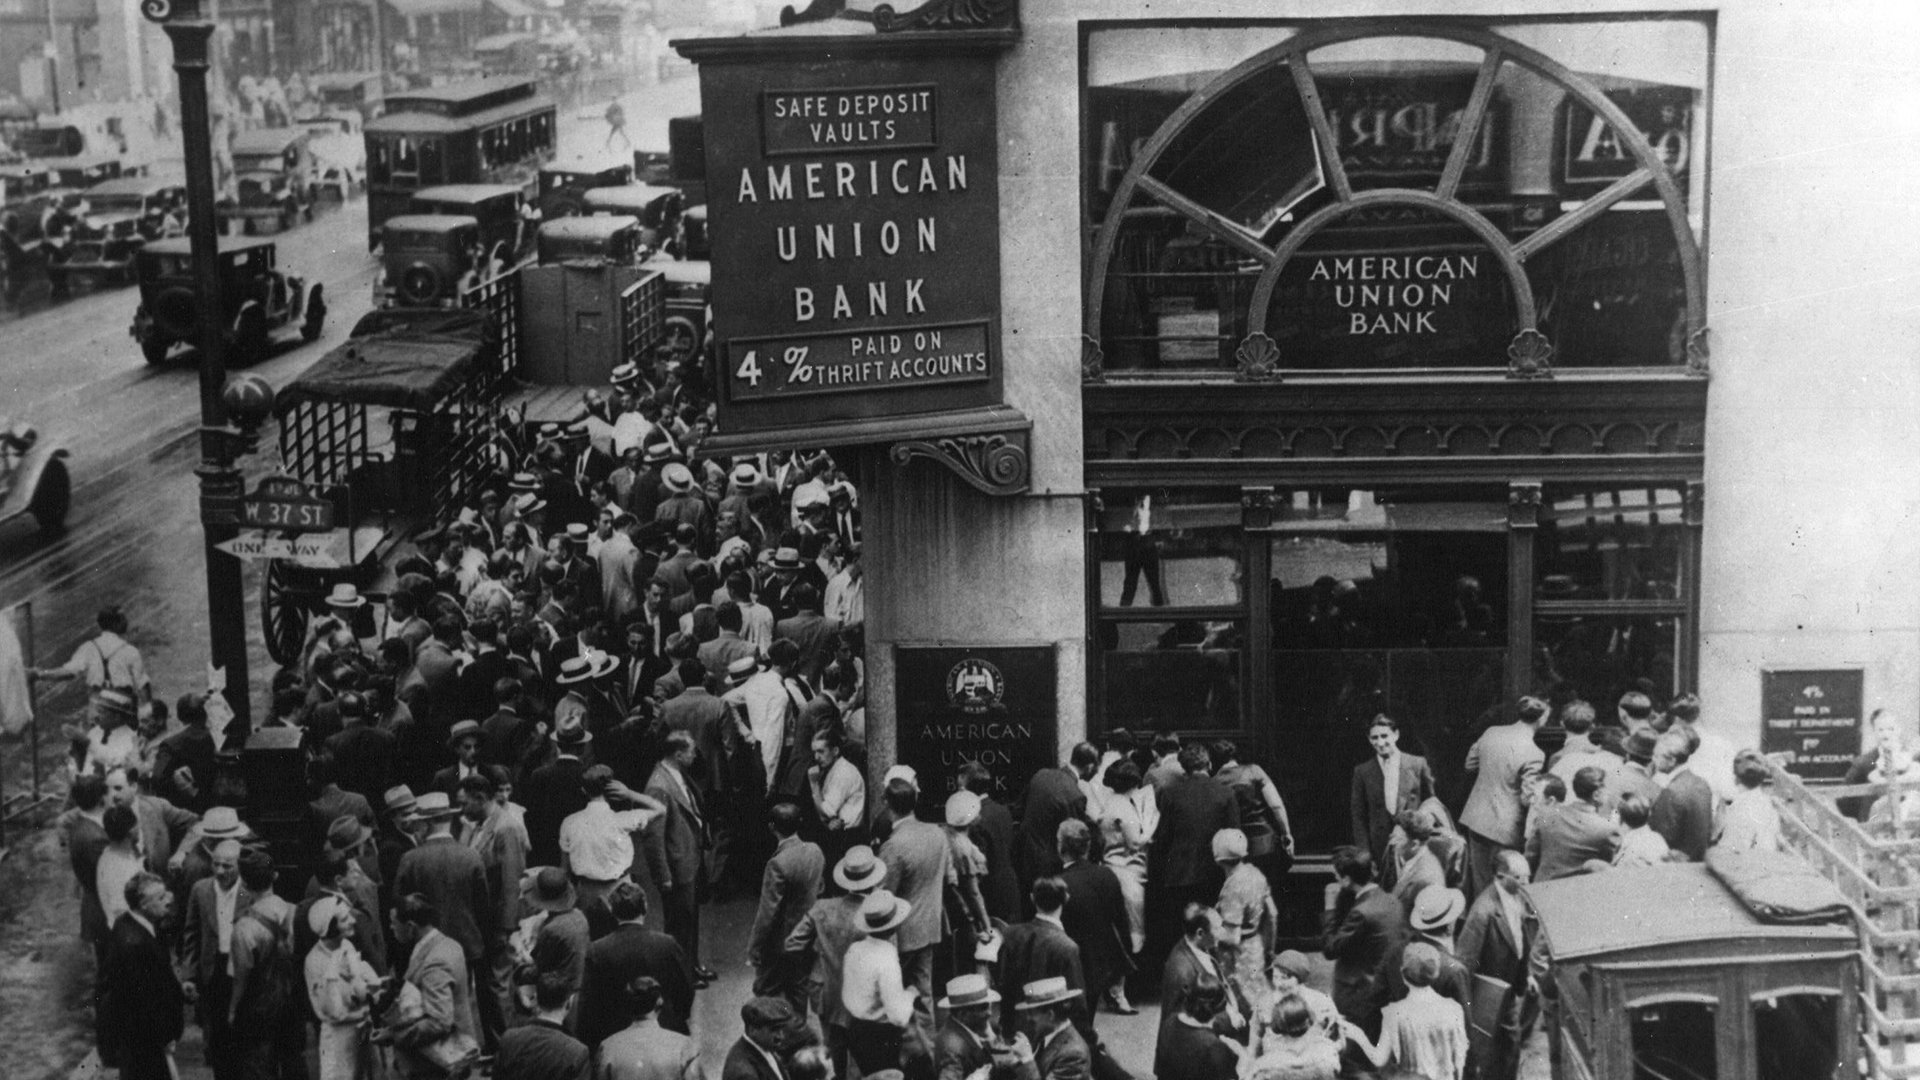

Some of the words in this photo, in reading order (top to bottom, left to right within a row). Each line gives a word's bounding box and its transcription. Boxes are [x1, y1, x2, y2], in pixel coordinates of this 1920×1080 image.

[775, 96, 828, 118] SAFE
[837, 91, 931, 116] DEPOSIT
[810, 119, 896, 143] VAULTS
[738, 155, 968, 203] AMERICAN
[777, 217, 937, 261] UNION
[1309, 256, 1478, 281] AMERICAN
[795, 278, 926, 321] BANK
[1335, 284, 1451, 308] UNION
[1350, 311, 1437, 335] BANK
[851, 335, 902, 356] PAID
[914, 331, 942, 351] ON
[736, 350, 763, 386] 4
[783, 346, 813, 383] %
[815, 363, 884, 385] THRIFT
[889, 352, 987, 379] ACCOUNTS
[268, 503, 293, 524] 37
[921, 721, 1031, 740] AMERICAN
[946, 775, 1007, 791] BK
